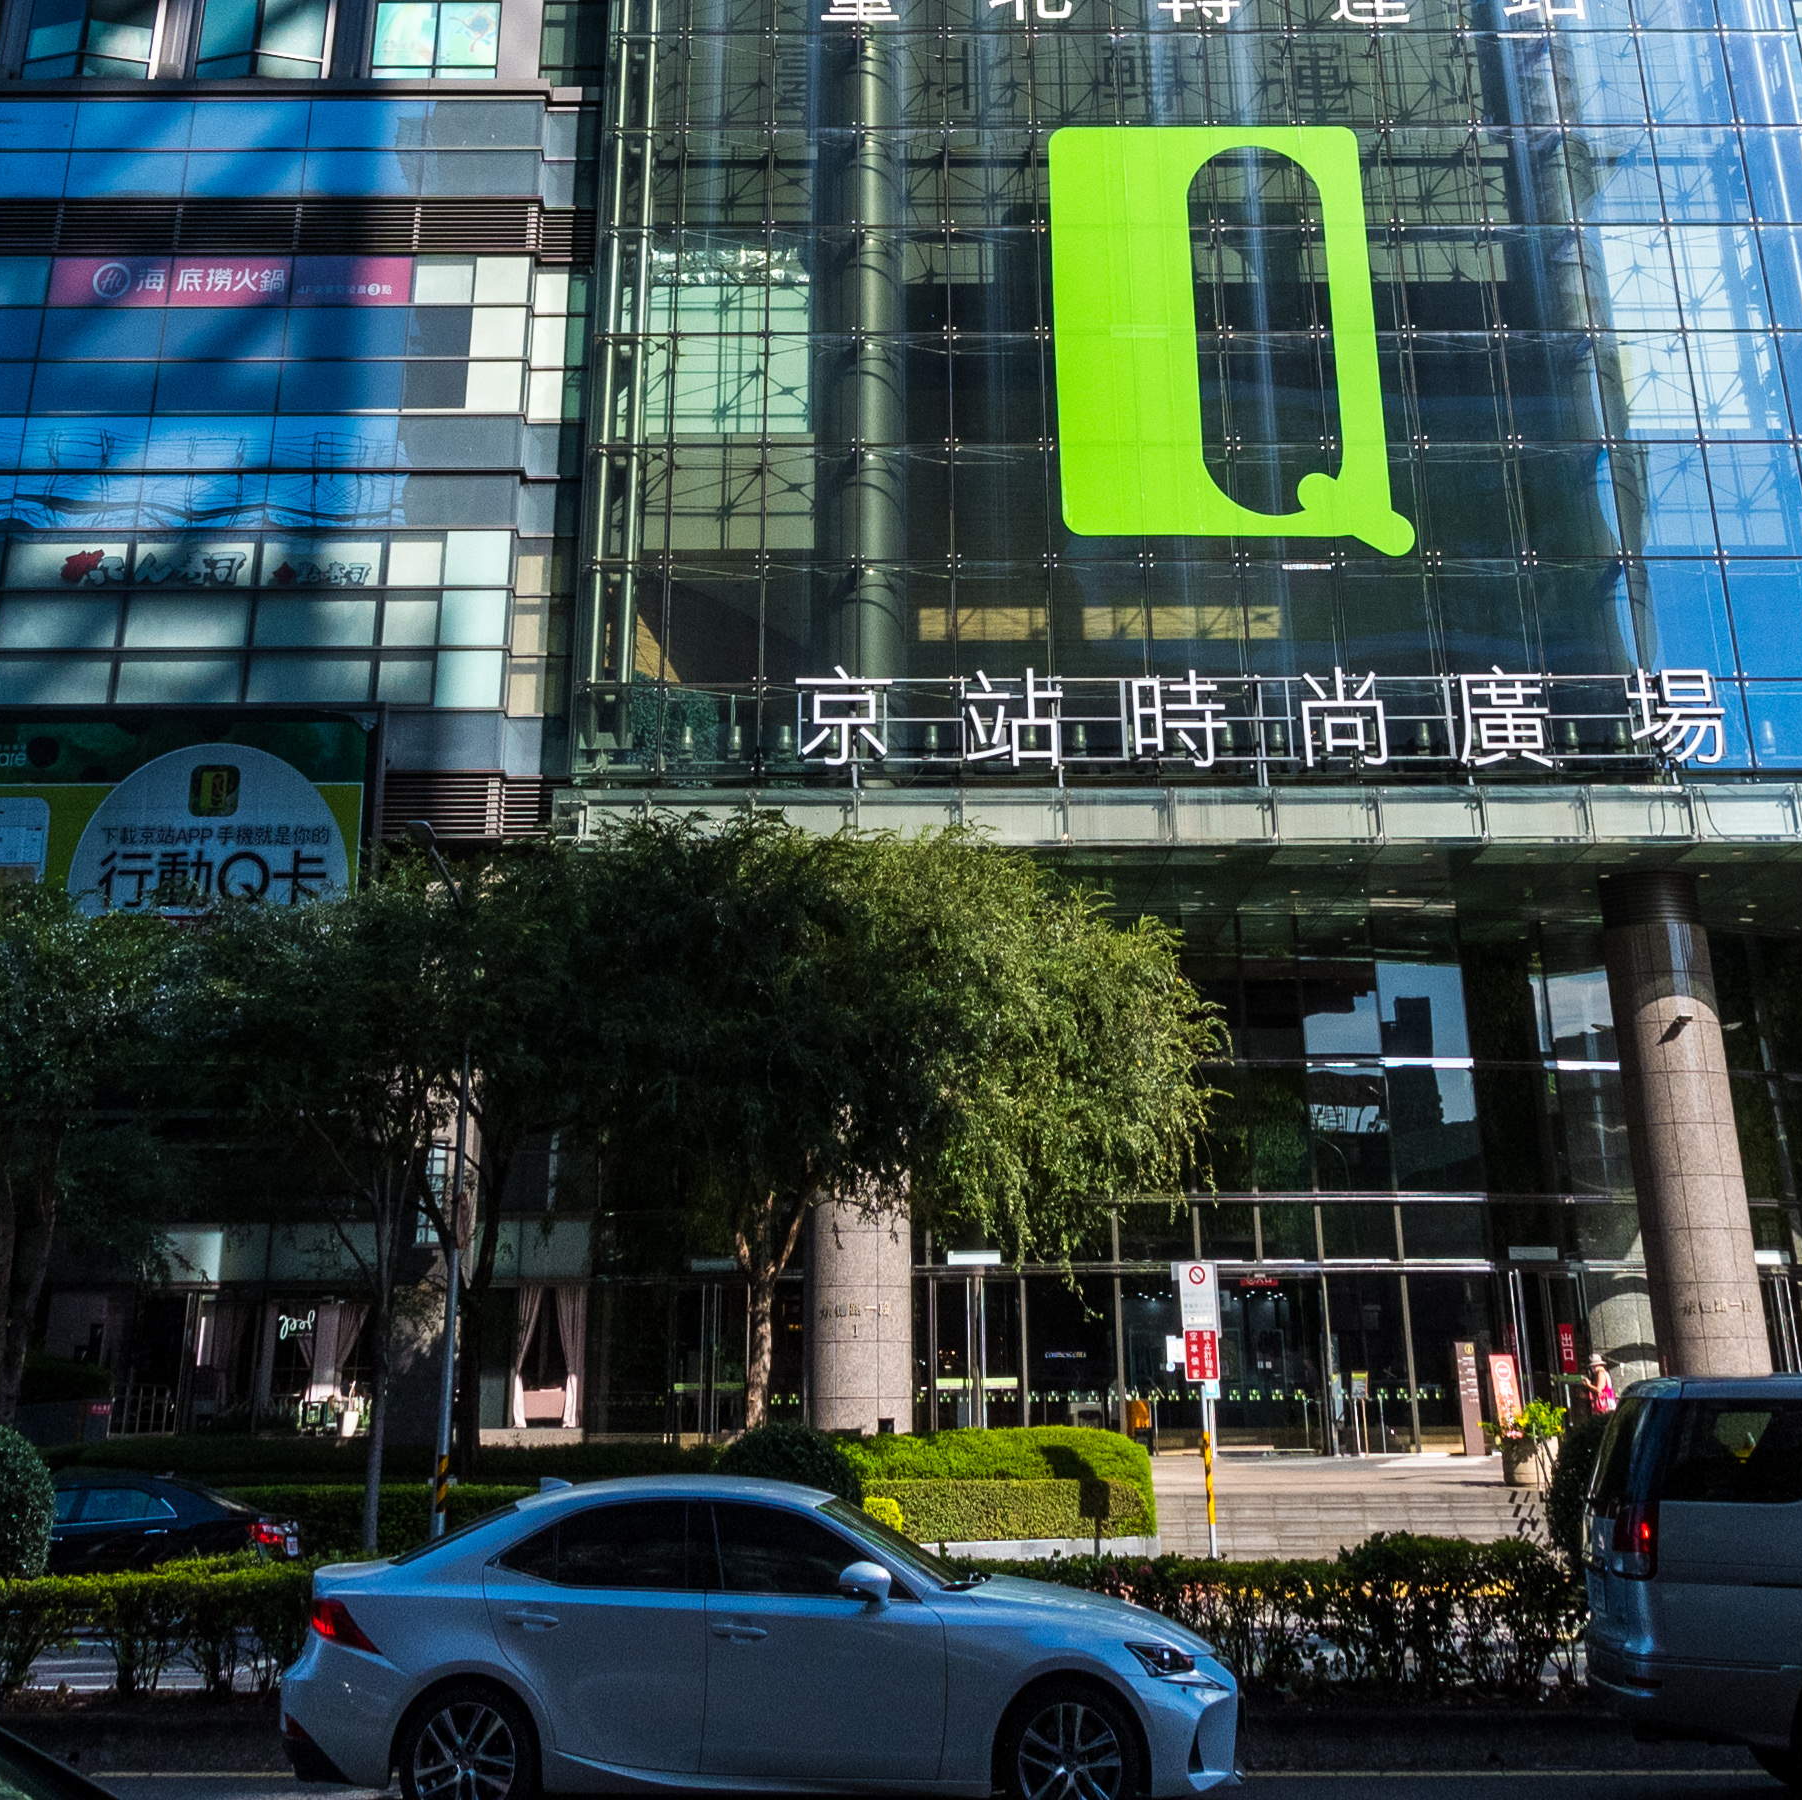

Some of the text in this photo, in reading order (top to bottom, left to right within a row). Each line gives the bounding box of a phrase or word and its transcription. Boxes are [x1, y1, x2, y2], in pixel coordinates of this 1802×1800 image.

[137, 267, 286, 293] 海底撈火鍋
[1048, 126, 1415, 557] Q
[796, 665, 1726, 770] 京站時尚廣場
[101, 826, 331, 847] 下載京站APP 手機就是你的
[98, 850, 328, 908] 行動Q卡
[1560, 1332, 1575, 1362] 出口
